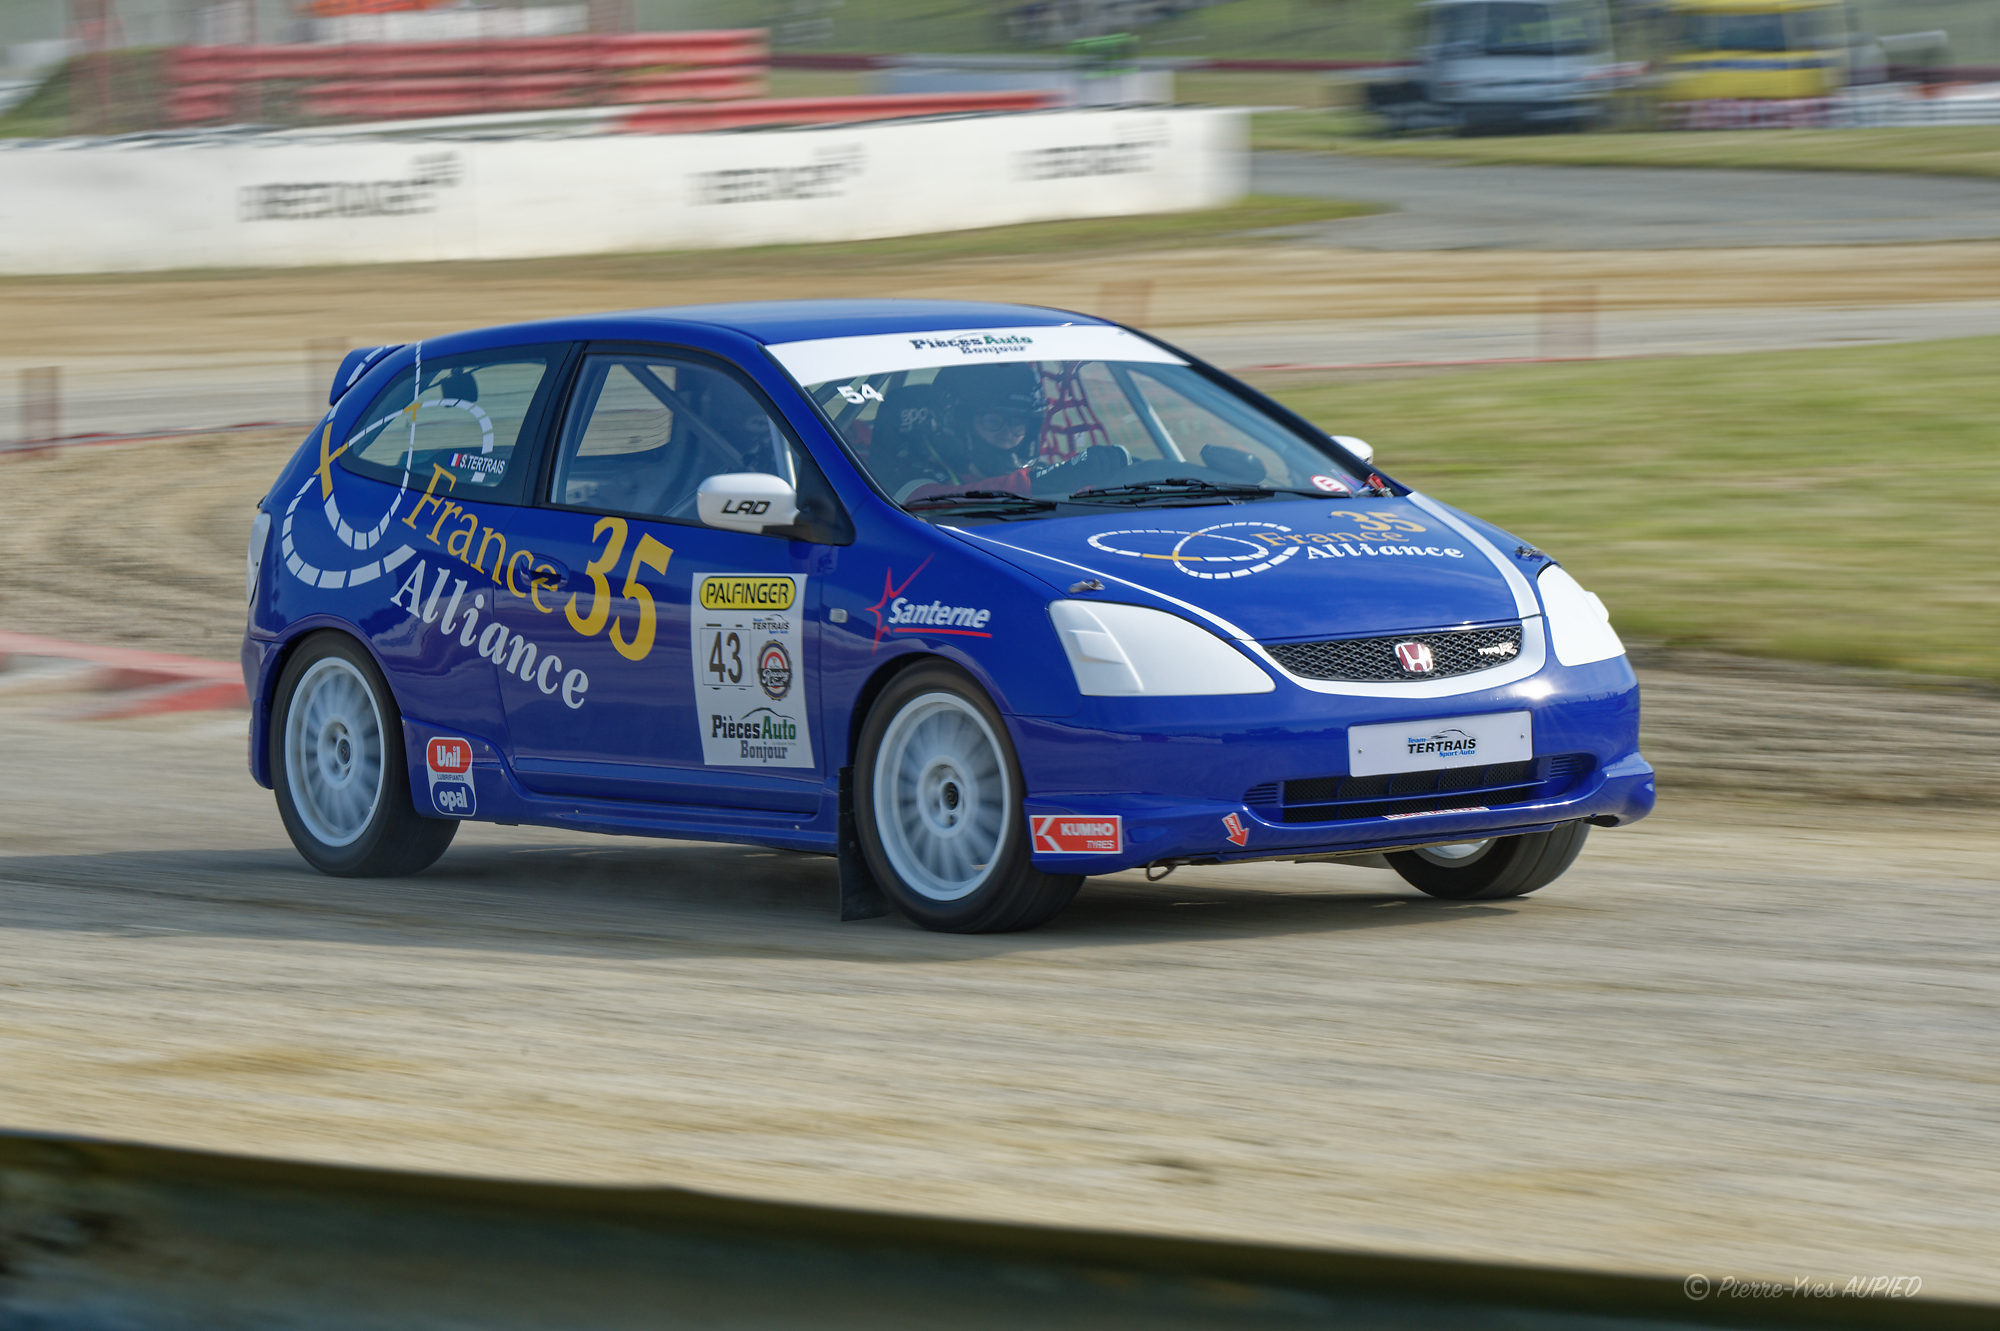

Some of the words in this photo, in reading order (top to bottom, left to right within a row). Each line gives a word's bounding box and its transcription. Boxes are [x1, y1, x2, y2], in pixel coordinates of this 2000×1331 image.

[836, 383, 885, 405] 54
[720, 499, 771, 515] LAD
[1330, 510, 1427, 533] 35
[1250, 531, 1410, 547] France
[402, 462, 560, 614] France
[564, 516, 675, 661] 35
[1306, 542, 1465, 560] Alliance
[706, 582, 789, 604] PALFINGER
[887, 597, 991, 629] Santerne
[390, 558, 590, 710] Alliance
[709, 631, 743, 684] 43
[436, 745, 461, 768] Unil
[741, 740, 788, 763] Bonjour
[1407, 738, 1477, 754] TERTRAIS
[439, 786, 468, 812] opal
[1060, 822, 1115, 836] KUMHO
